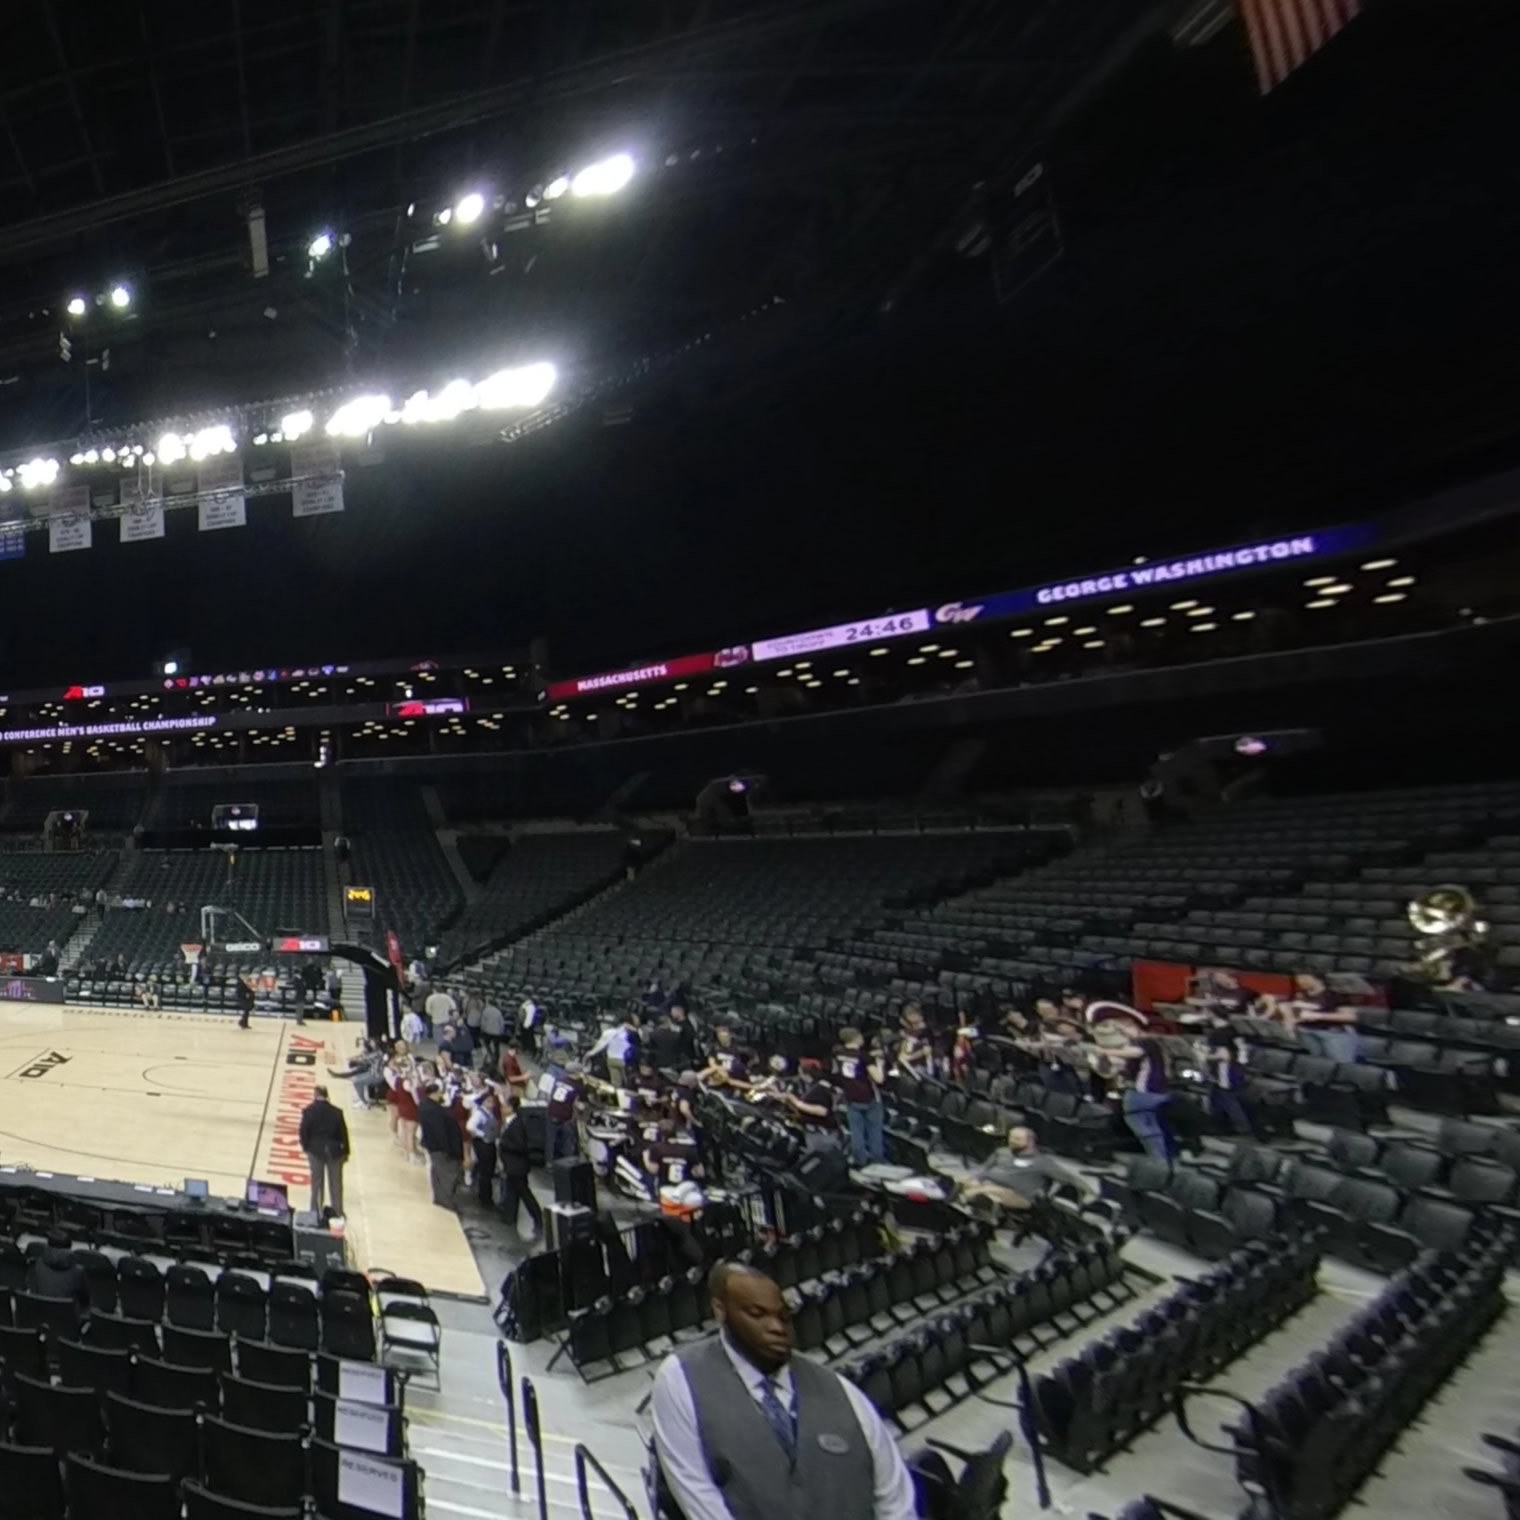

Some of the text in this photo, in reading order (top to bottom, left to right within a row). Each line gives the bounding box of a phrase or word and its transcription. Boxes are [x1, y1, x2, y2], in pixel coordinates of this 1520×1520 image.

[1036, 536, 1314, 604] GEORGE WASHINGTON
[846, 616, 914, 642] 24:46
[577, 664, 668, 692] MASSACHUSETTS
[64, 685, 105, 699] A10
[4, 728, 56, 742] CONFERENCE
[86, 722, 142, 736] BASKETBALL
[144, 716, 217, 732] CHAMPIONSHIP
[225, 942, 260, 952] GEICO
[280, 937, 321, 951] A10
[286, 1033, 325, 1065] A10
[19, 1051, 73, 1078] A10
